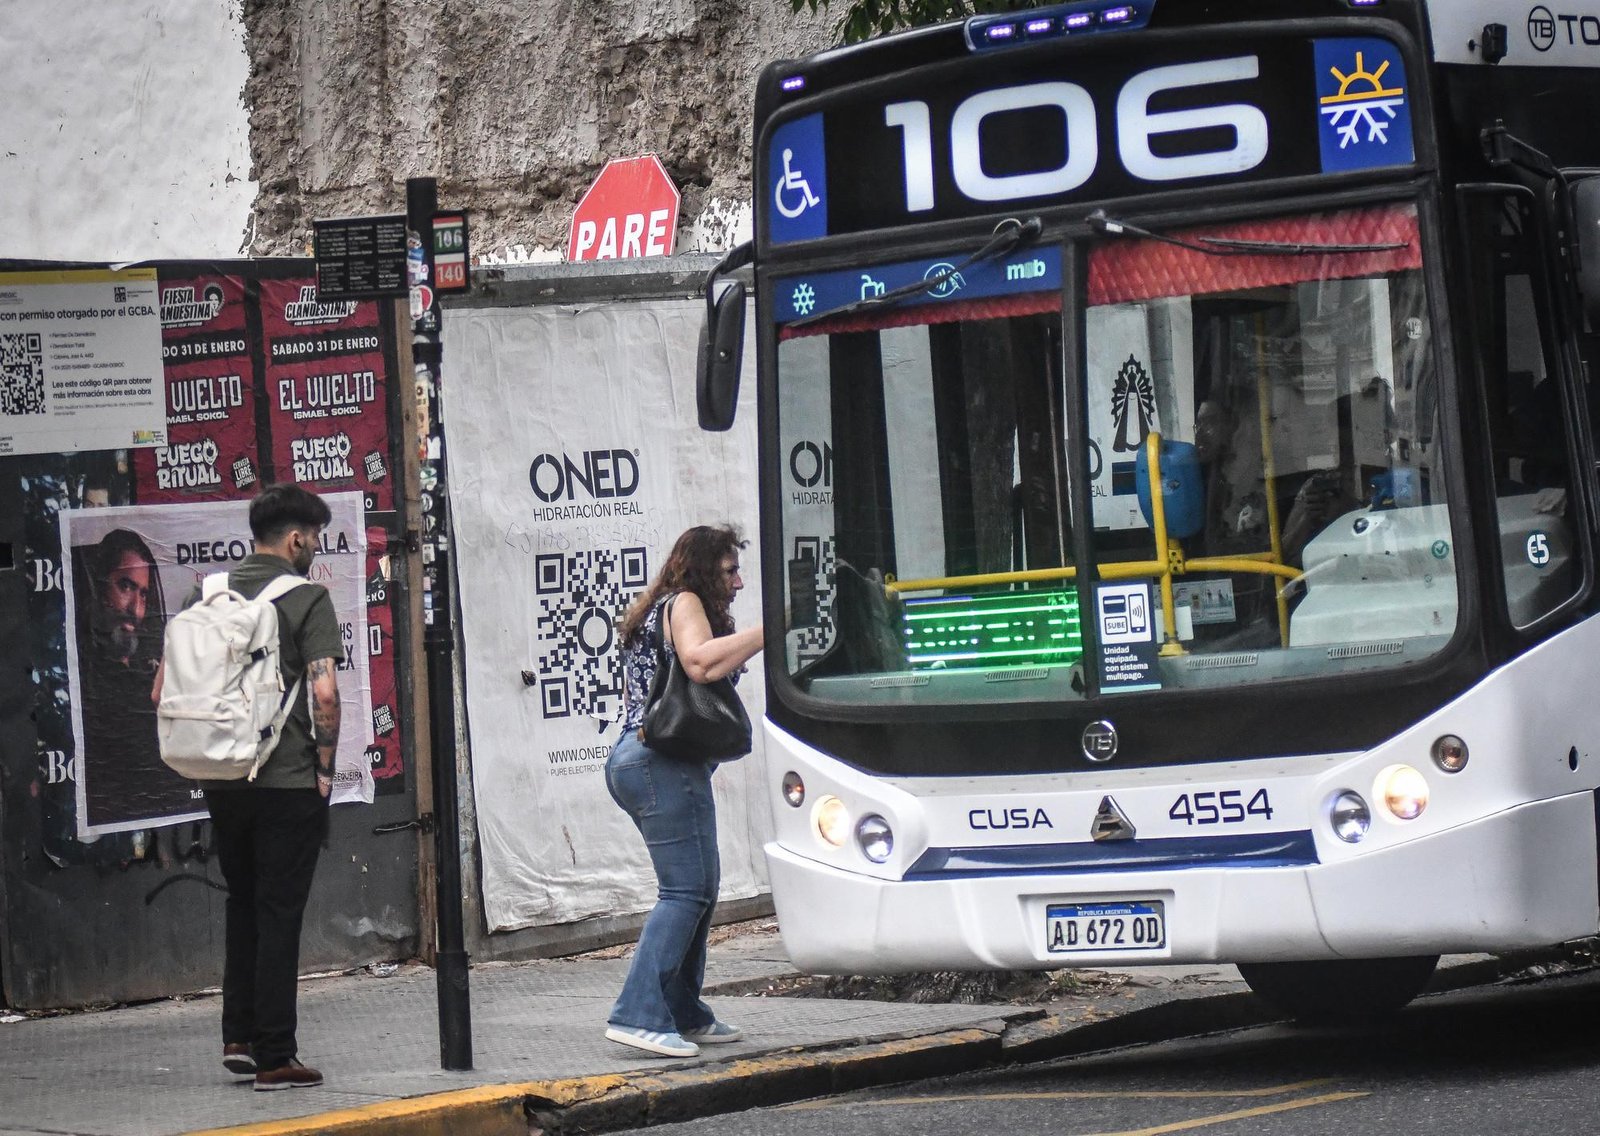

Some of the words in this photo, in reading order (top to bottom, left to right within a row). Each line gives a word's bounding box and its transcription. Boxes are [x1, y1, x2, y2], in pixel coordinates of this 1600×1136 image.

[885, 55, 1269, 213] 106
[435, 229, 463, 248] 106
[575, 209, 669, 260] PARE
[438, 265, 464, 283] 140
[163, 288, 194, 305] FIESTA
[0, 313, 17, 321] con
[19, 308, 55, 322] permiso
[57, 307, 98, 321] otorgado
[101, 308, 116, 320] por
[118, 307, 126, 316] el
[128, 306, 156, 317] GCBA.
[286, 301, 348, 320] CLANDESTINA
[163, 346, 178, 357] DO
[181, 344, 191, 355] 31
[195, 343, 207, 354] DE
[211, 340, 246, 353] ENERO
[272, 342, 314, 355] SABADO
[317, 341, 327, 351] 31
[331, 340, 343, 350] DE
[346, 337, 378, 349] ENERO
[52, 381, 64, 389] Lea
[79, 378, 101, 389] código
[103, 378, 113, 386] QR
[114, 379, 127, 387] para
[279, 379, 303, 410] EL
[307, 372, 375, 407] VUELTO
[67, 389, 104, 398] información
[171, 375, 243, 412] VUELTO
[196, 411, 229, 421] SOKOL
[294, 410, 328, 419] ISMAEL
[331, 406, 362, 416] SOKOL
[155, 438, 218, 467] FUEGO
[291, 432, 351, 460] FUEGO
[235, 464, 253, 481] LIBRE
[366, 458, 383, 474] LIBRE
[529, 449, 640, 503] ONED
[533, 502, 611, 522] HIDRATACIÓN
[614, 501, 644, 516] REAL
[176, 540, 246, 565] DIEGO
[1107, 621, 1125, 629] SUBE
[1104, 646, 1130, 654] Unidad
[1105, 655, 1138, 664] equipada
[1120, 663, 1149, 671] sistema
[1106, 672, 1144, 681] multipago.
[375, 712, 392, 728] LIBRE
[548, 745, 612, 764] WWW.ONED
[550, 767, 568, 776] PURE
[1169, 788, 1273, 826] 4554
[969, 808, 1053, 830] CUSA
[1053, 921, 1079, 946] AD
[1087, 918, 1125, 944] 672
